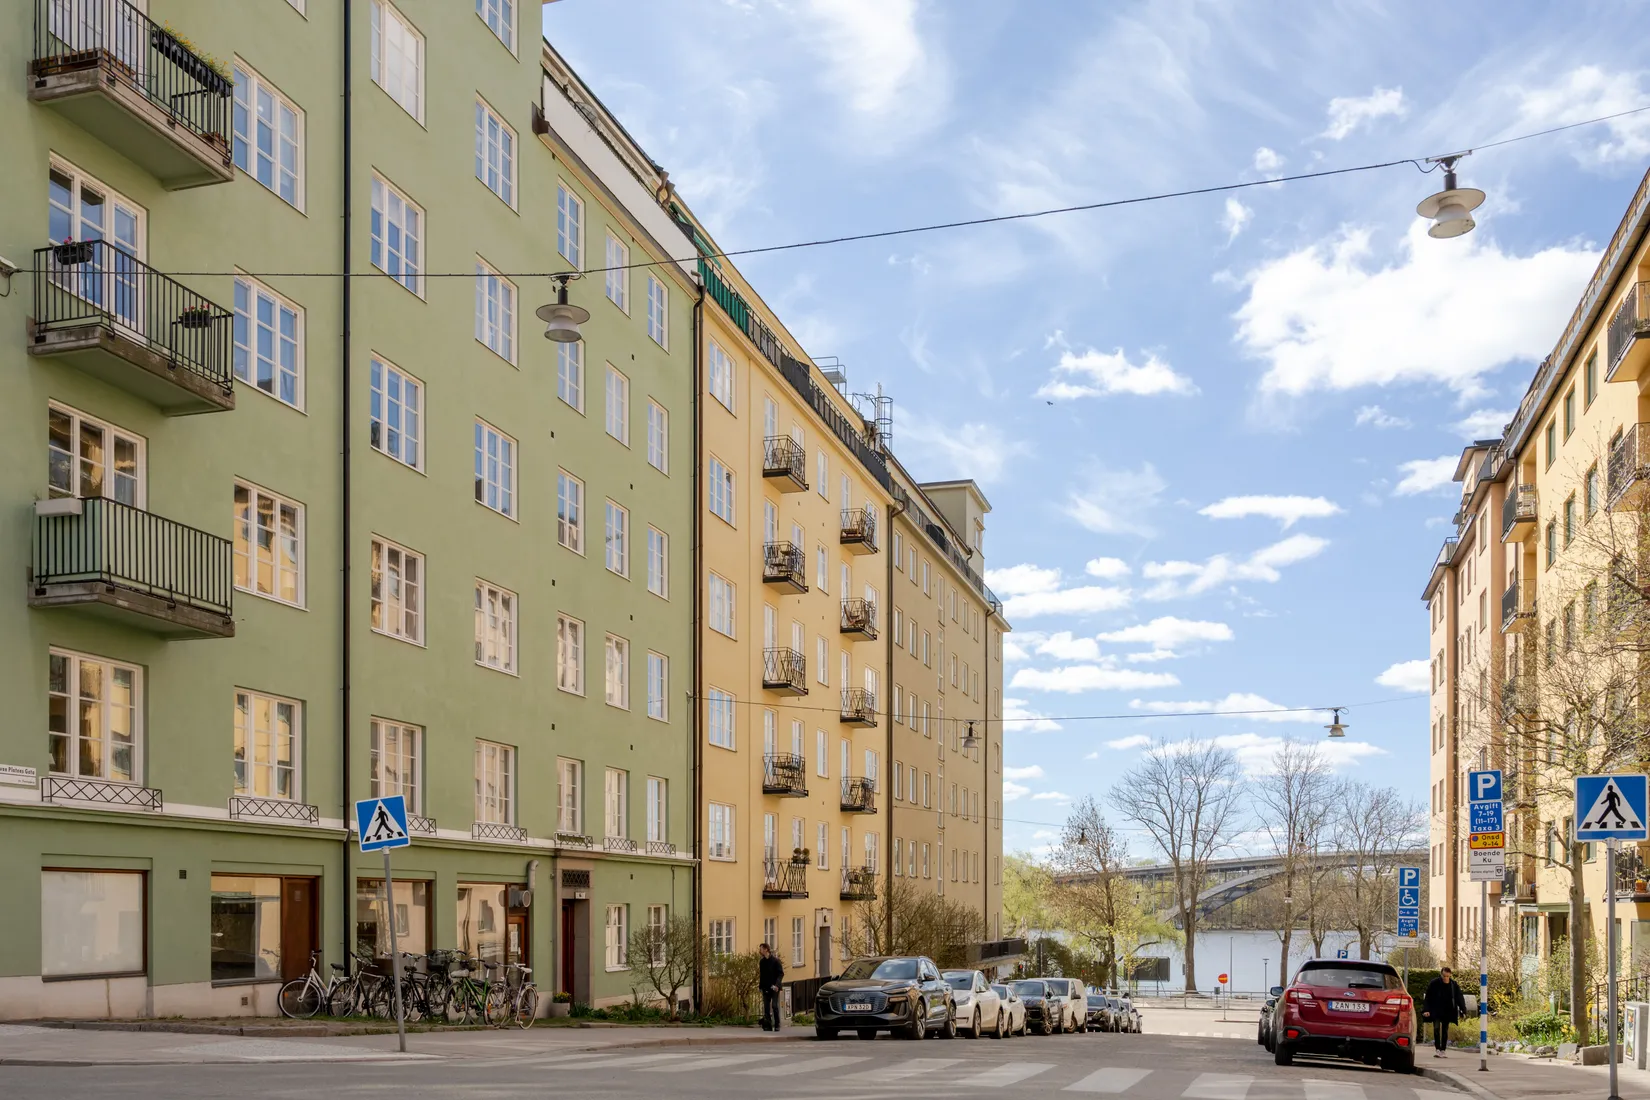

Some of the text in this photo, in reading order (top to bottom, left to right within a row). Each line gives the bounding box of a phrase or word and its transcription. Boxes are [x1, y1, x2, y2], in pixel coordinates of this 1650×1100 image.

[1477, 774, 1496, 798] P
[1404, 869, 1416, 886] P
[1340, 950, 1346, 958] P
